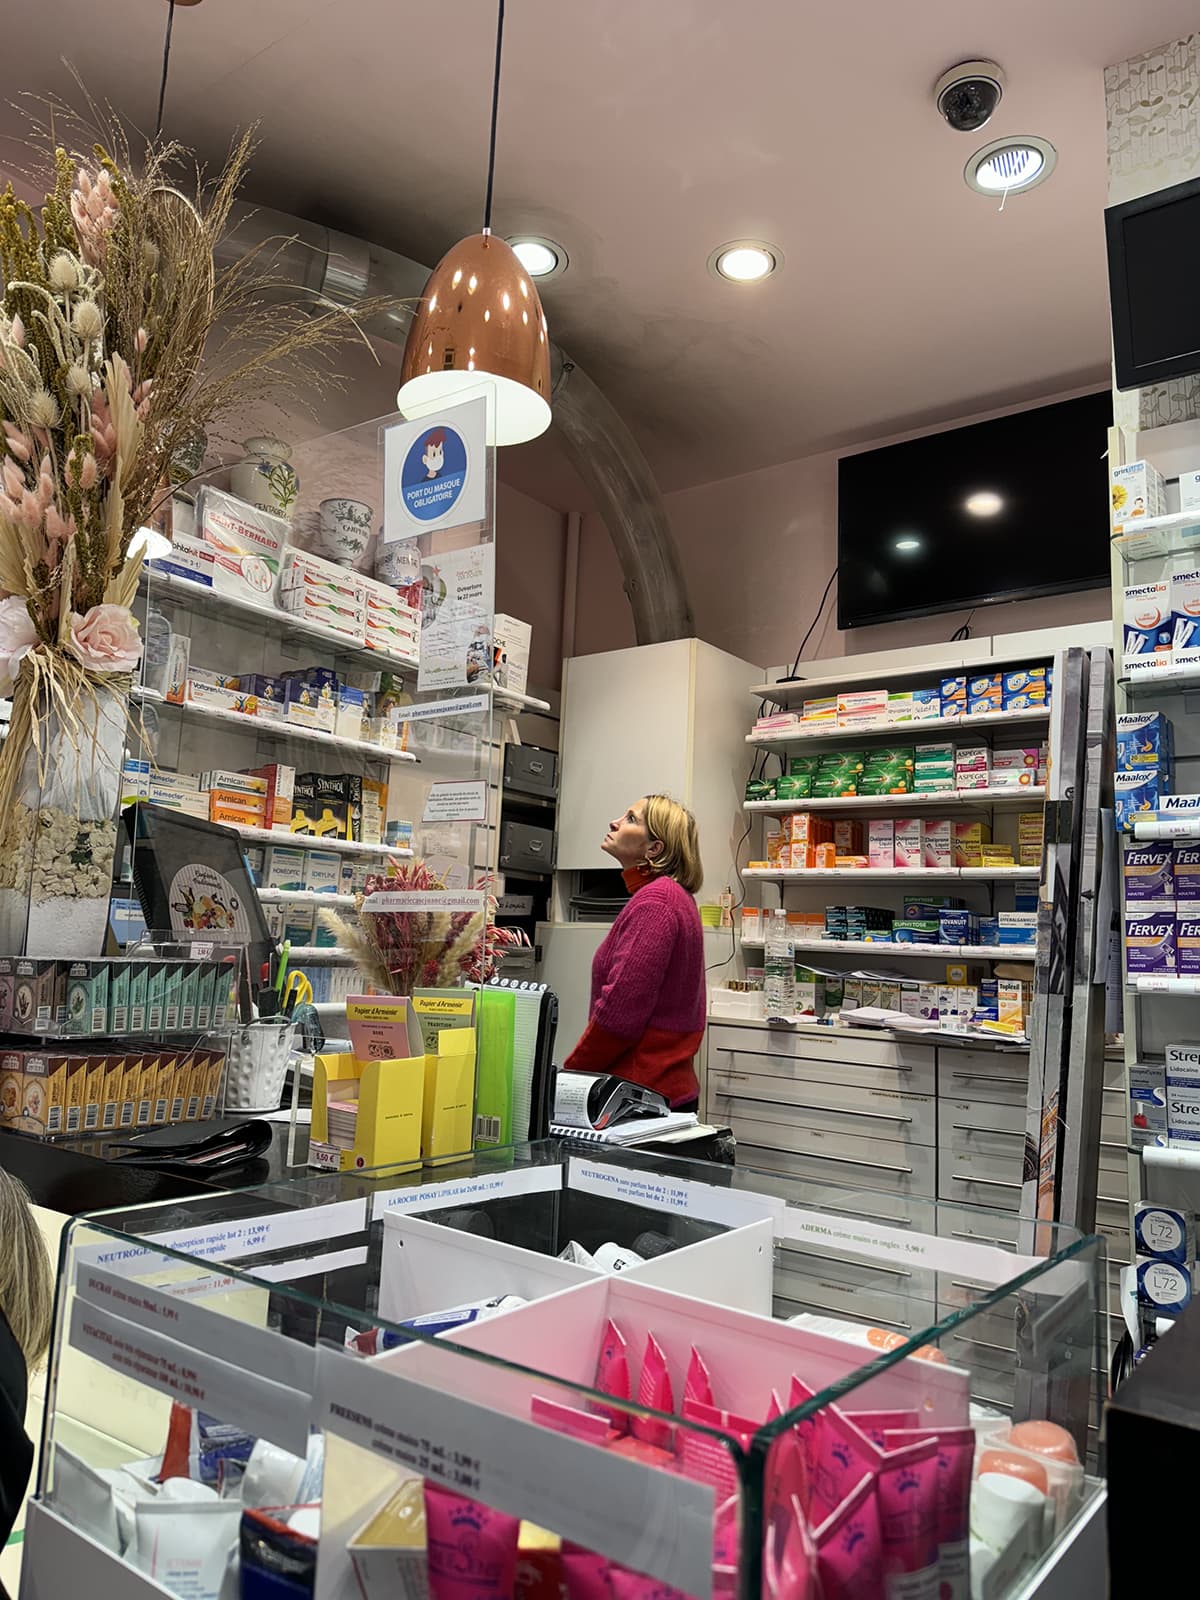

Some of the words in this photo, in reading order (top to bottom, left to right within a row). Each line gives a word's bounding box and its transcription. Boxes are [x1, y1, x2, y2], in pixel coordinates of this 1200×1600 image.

[407, 488, 424, 500] PORT
[424, 486, 433, 496] DU
[433, 478, 461, 492] MASQUE
[413, 490, 453, 508] OBLIGATOIRE
[456, 582, 482, 593] Ouverture
[1125, 583, 1167, 597] smectalia
[1125, 658, 1168, 670] smectalia
[1118, 713, 1153, 724] Maalox
[218, 774, 246, 786] Arnican
[1116, 772, 1151, 782] Maalox
[317, 777, 344, 794] SYNTHOL
[153, 789, 184, 800] Hémoclar
[218, 793, 247, 805] Arnican
[219, 811, 246, 823] Arnican
[1127, 851, 1173, 865] FERVEX
[1128, 922, 1174, 937] FERVEX
[419, 1000, 436, 1008] Papier
[354, 1006, 371, 1016] Papier
[580, 1169, 619, 1183] NEUTROGENA
[397, 1196, 417, 1205] ROCHE
[419, 1193, 437, 1201] POSAY
[800, 1223, 832, 1236] ADERMA
[1150, 1223, 1173, 1239] L72
[170, 1235, 204, 1250] absorption
[205, 1233, 226, 1245] rapide
[227, 1230, 237, 1240] lot
[248, 1226, 265, 1237] 13,99
[206, 1243, 226, 1255] rapide
[1153, 1275, 1178, 1291] L72
